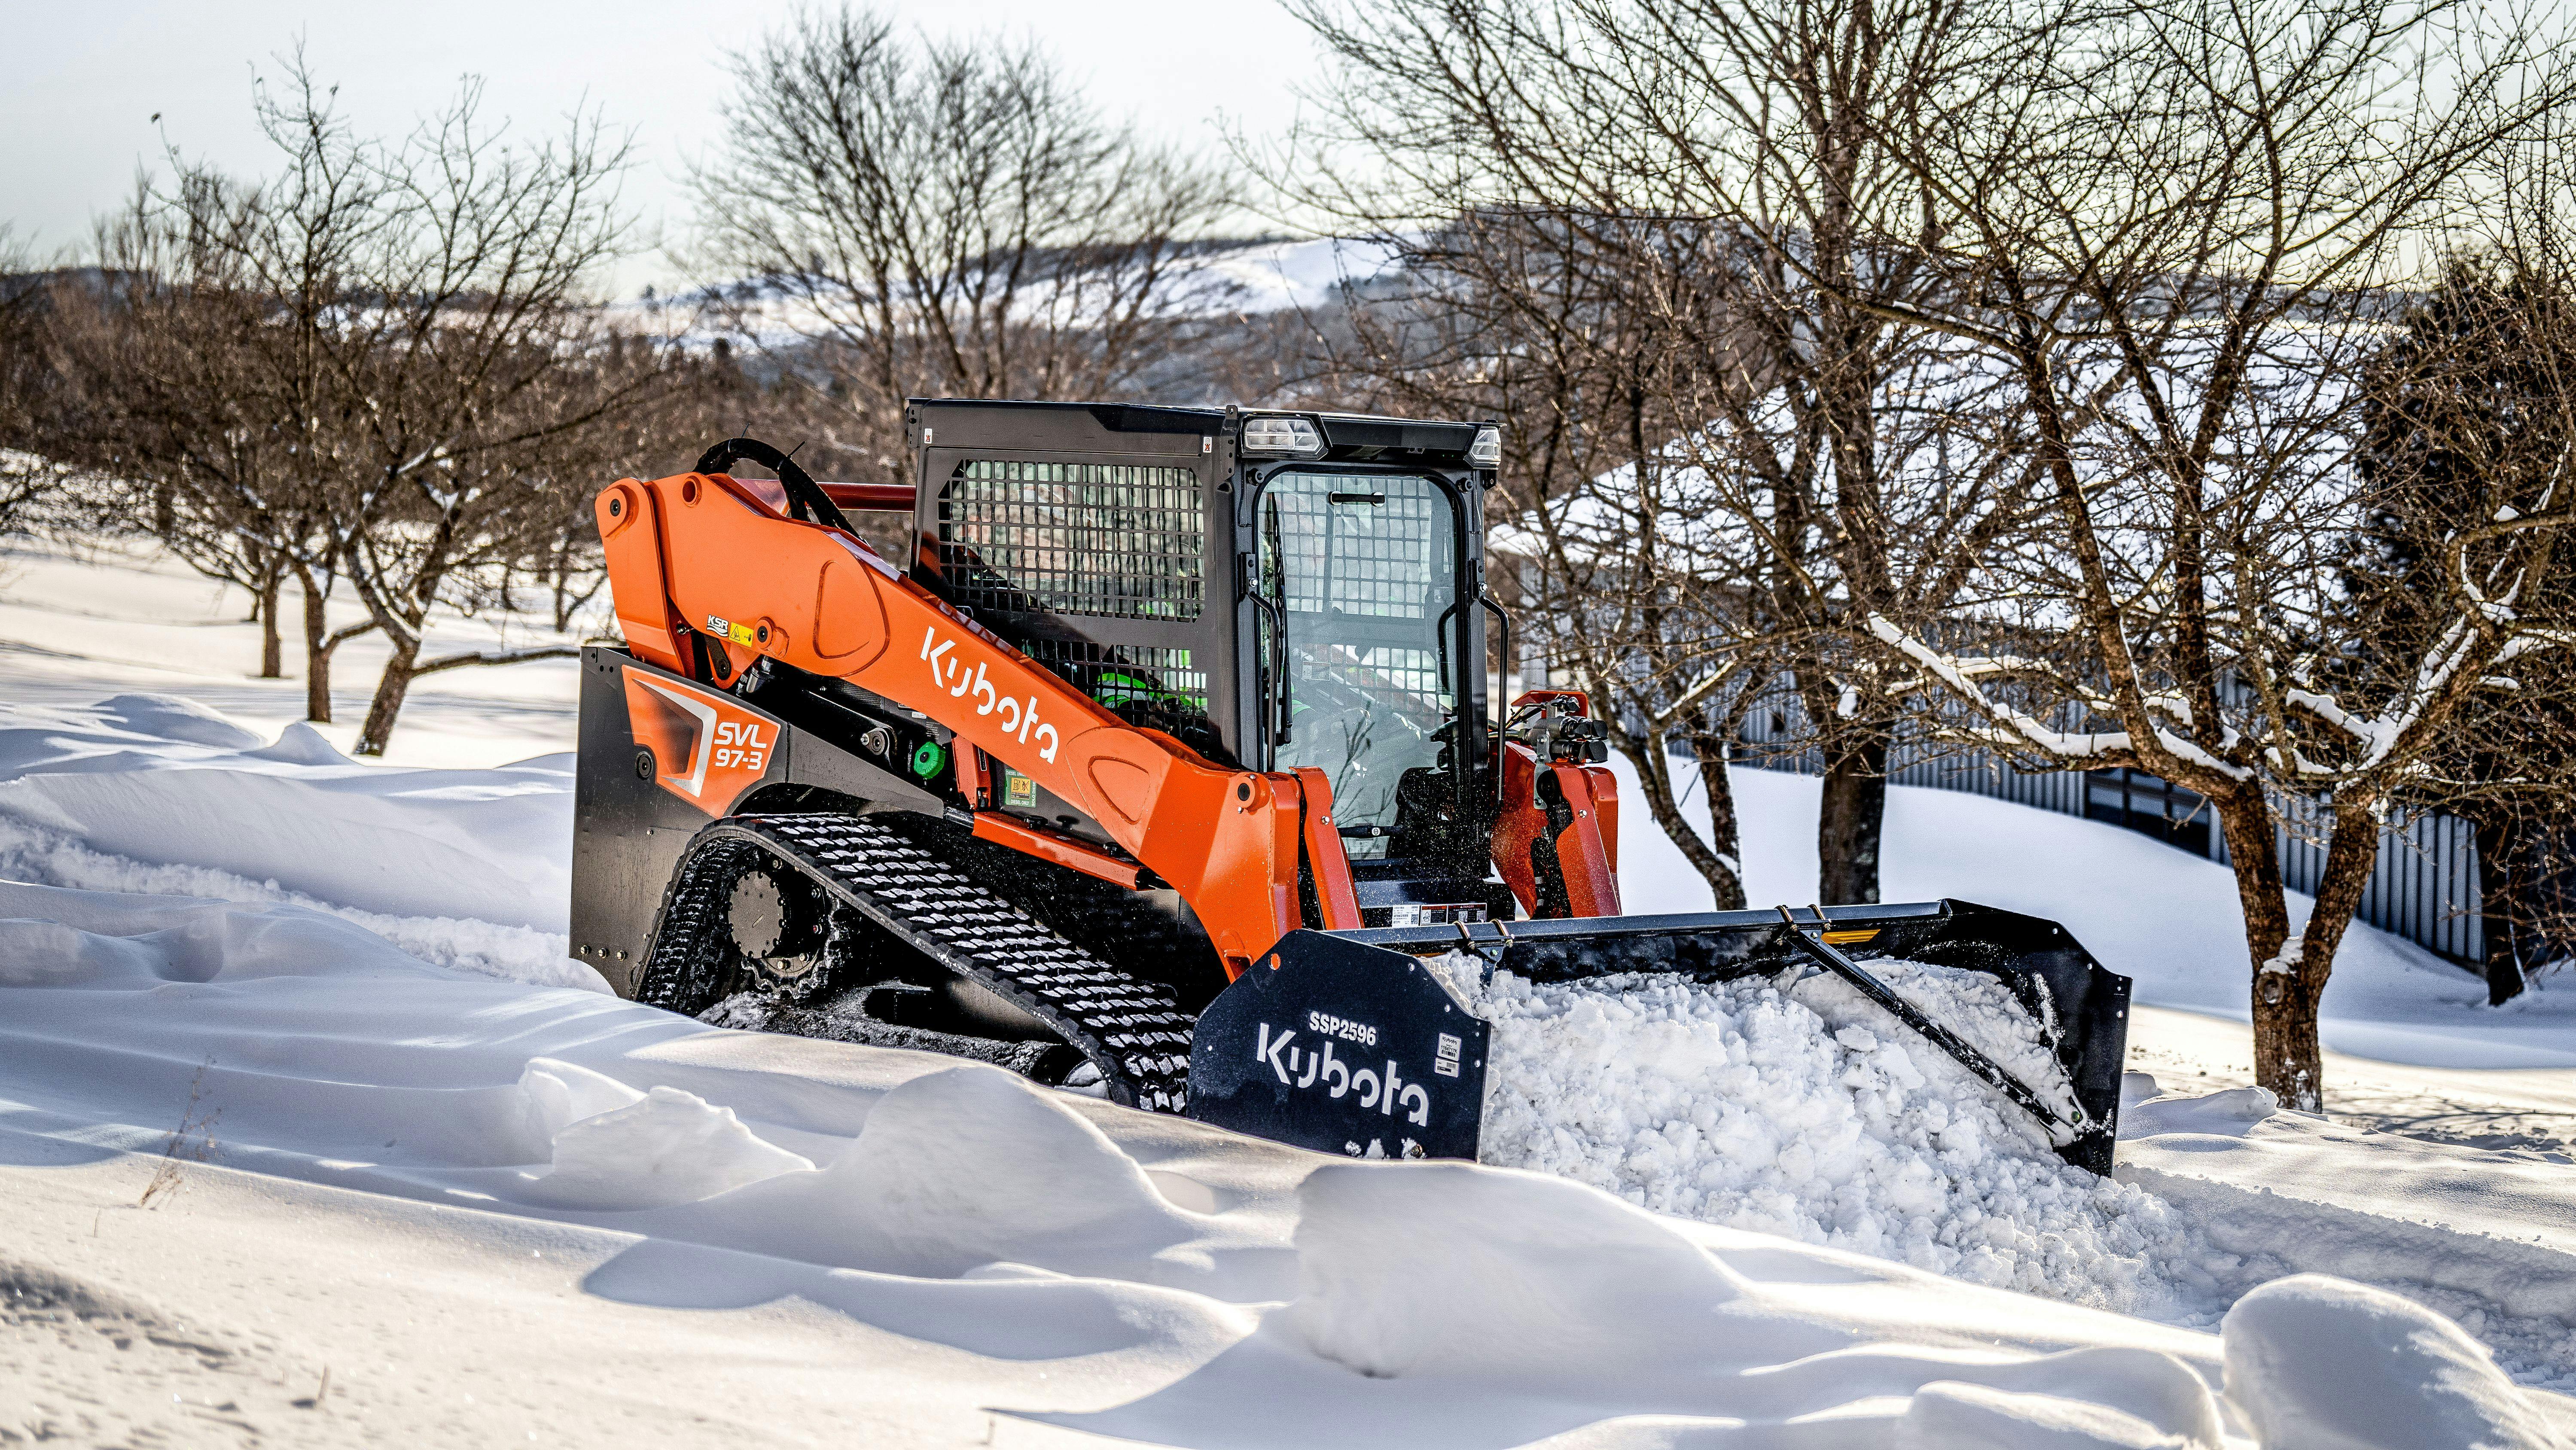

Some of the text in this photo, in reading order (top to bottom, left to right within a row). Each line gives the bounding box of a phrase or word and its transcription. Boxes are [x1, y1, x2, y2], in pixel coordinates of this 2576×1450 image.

[707, 614, 729, 630] KSR
[920, 625, 1059, 765] Kubota
[713, 722, 767, 749] SVL
[715, 748, 763, 770] 97-3
[1309, 1011, 1377, 1046] SSP2596
[1442, 1036, 1457, 1045] Kubota
[1441, 1045, 1457, 1054] 1164717K
[1256, 1022, 1429, 1127] Kubota
